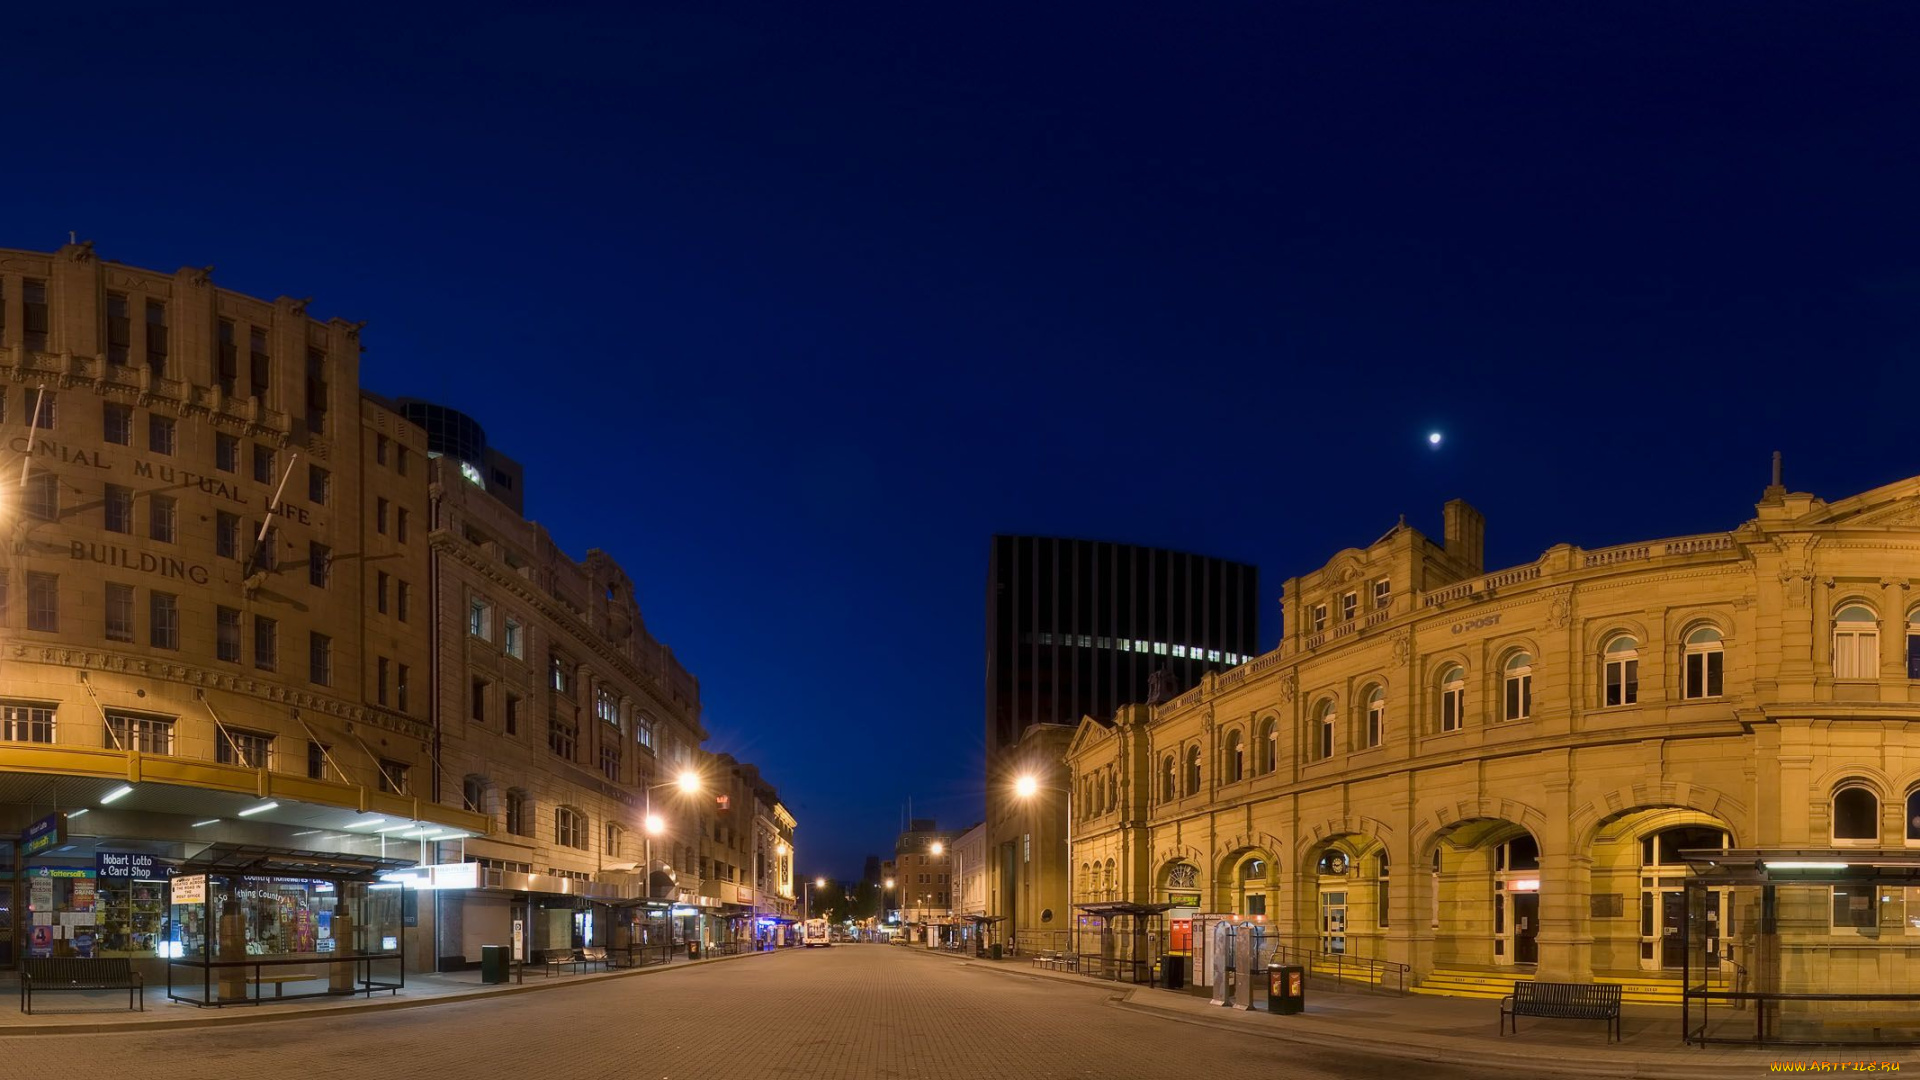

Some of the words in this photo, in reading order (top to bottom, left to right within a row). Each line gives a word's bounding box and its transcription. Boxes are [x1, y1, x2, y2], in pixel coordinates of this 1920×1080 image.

[134, 459, 248, 505] MUTUAL
[265, 495, 312, 526] LIFE
[69, 539, 209, 585] BUILDING
[1465, 613, 1502, 631] POST
[103, 853, 129, 865] Hobart
[132, 854, 152, 866] Lotto
[100, 868, 107, 876] &
[108, 865, 129, 877] Card
[131, 867, 151, 879] Shop
[258, 889, 285, 904] Country
